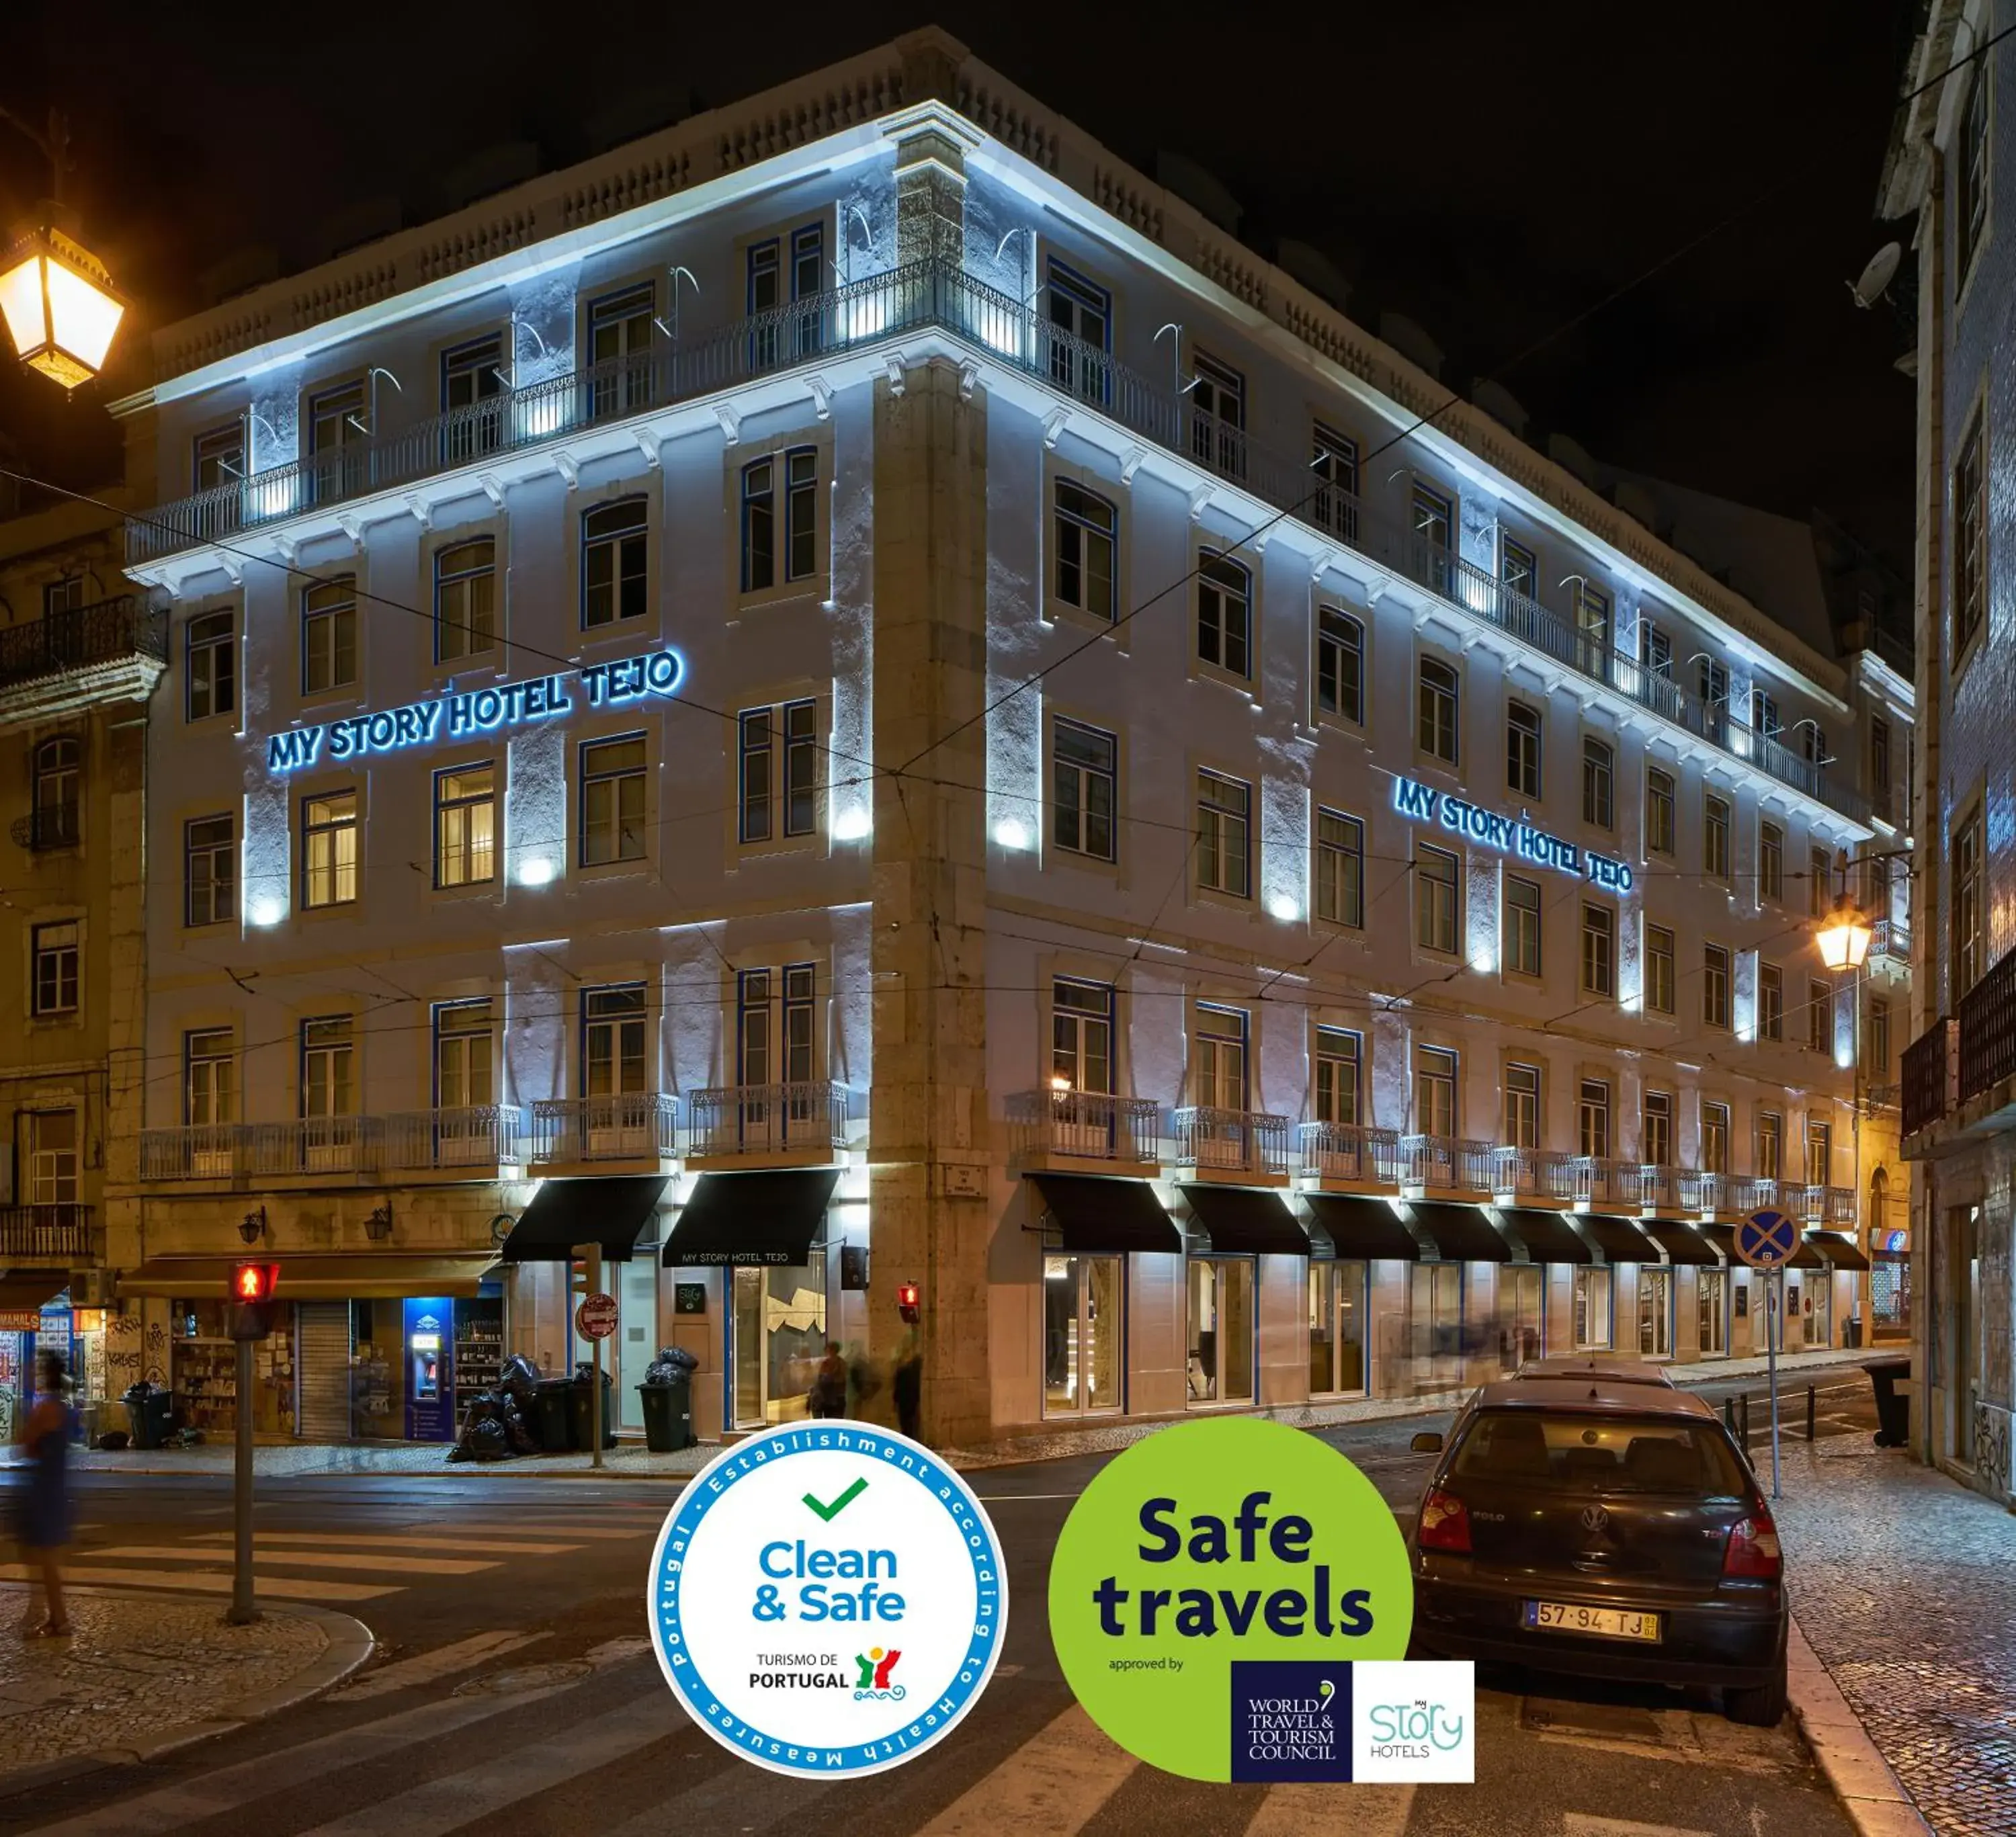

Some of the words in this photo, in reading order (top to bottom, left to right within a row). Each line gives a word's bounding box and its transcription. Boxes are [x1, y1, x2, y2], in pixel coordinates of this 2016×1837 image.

[269, 728, 321, 769] MY
[329, 701, 439, 757] STORY
[450, 675, 569, 732] HOTEL
[582, 650, 681, 705] TEJO
[1397, 777, 1437, 818] MY
[1441, 795, 1515, 850] STORY
[1517, 826, 1583, 875] HOTEL
[1586, 851, 1633, 892] TEJO
[682, 1253, 697, 1263] MY
[700, 1253, 728, 1263] STORY
[732, 1252, 762, 1262] HOTEL
[765, 1252, 788, 1262] TEJO
